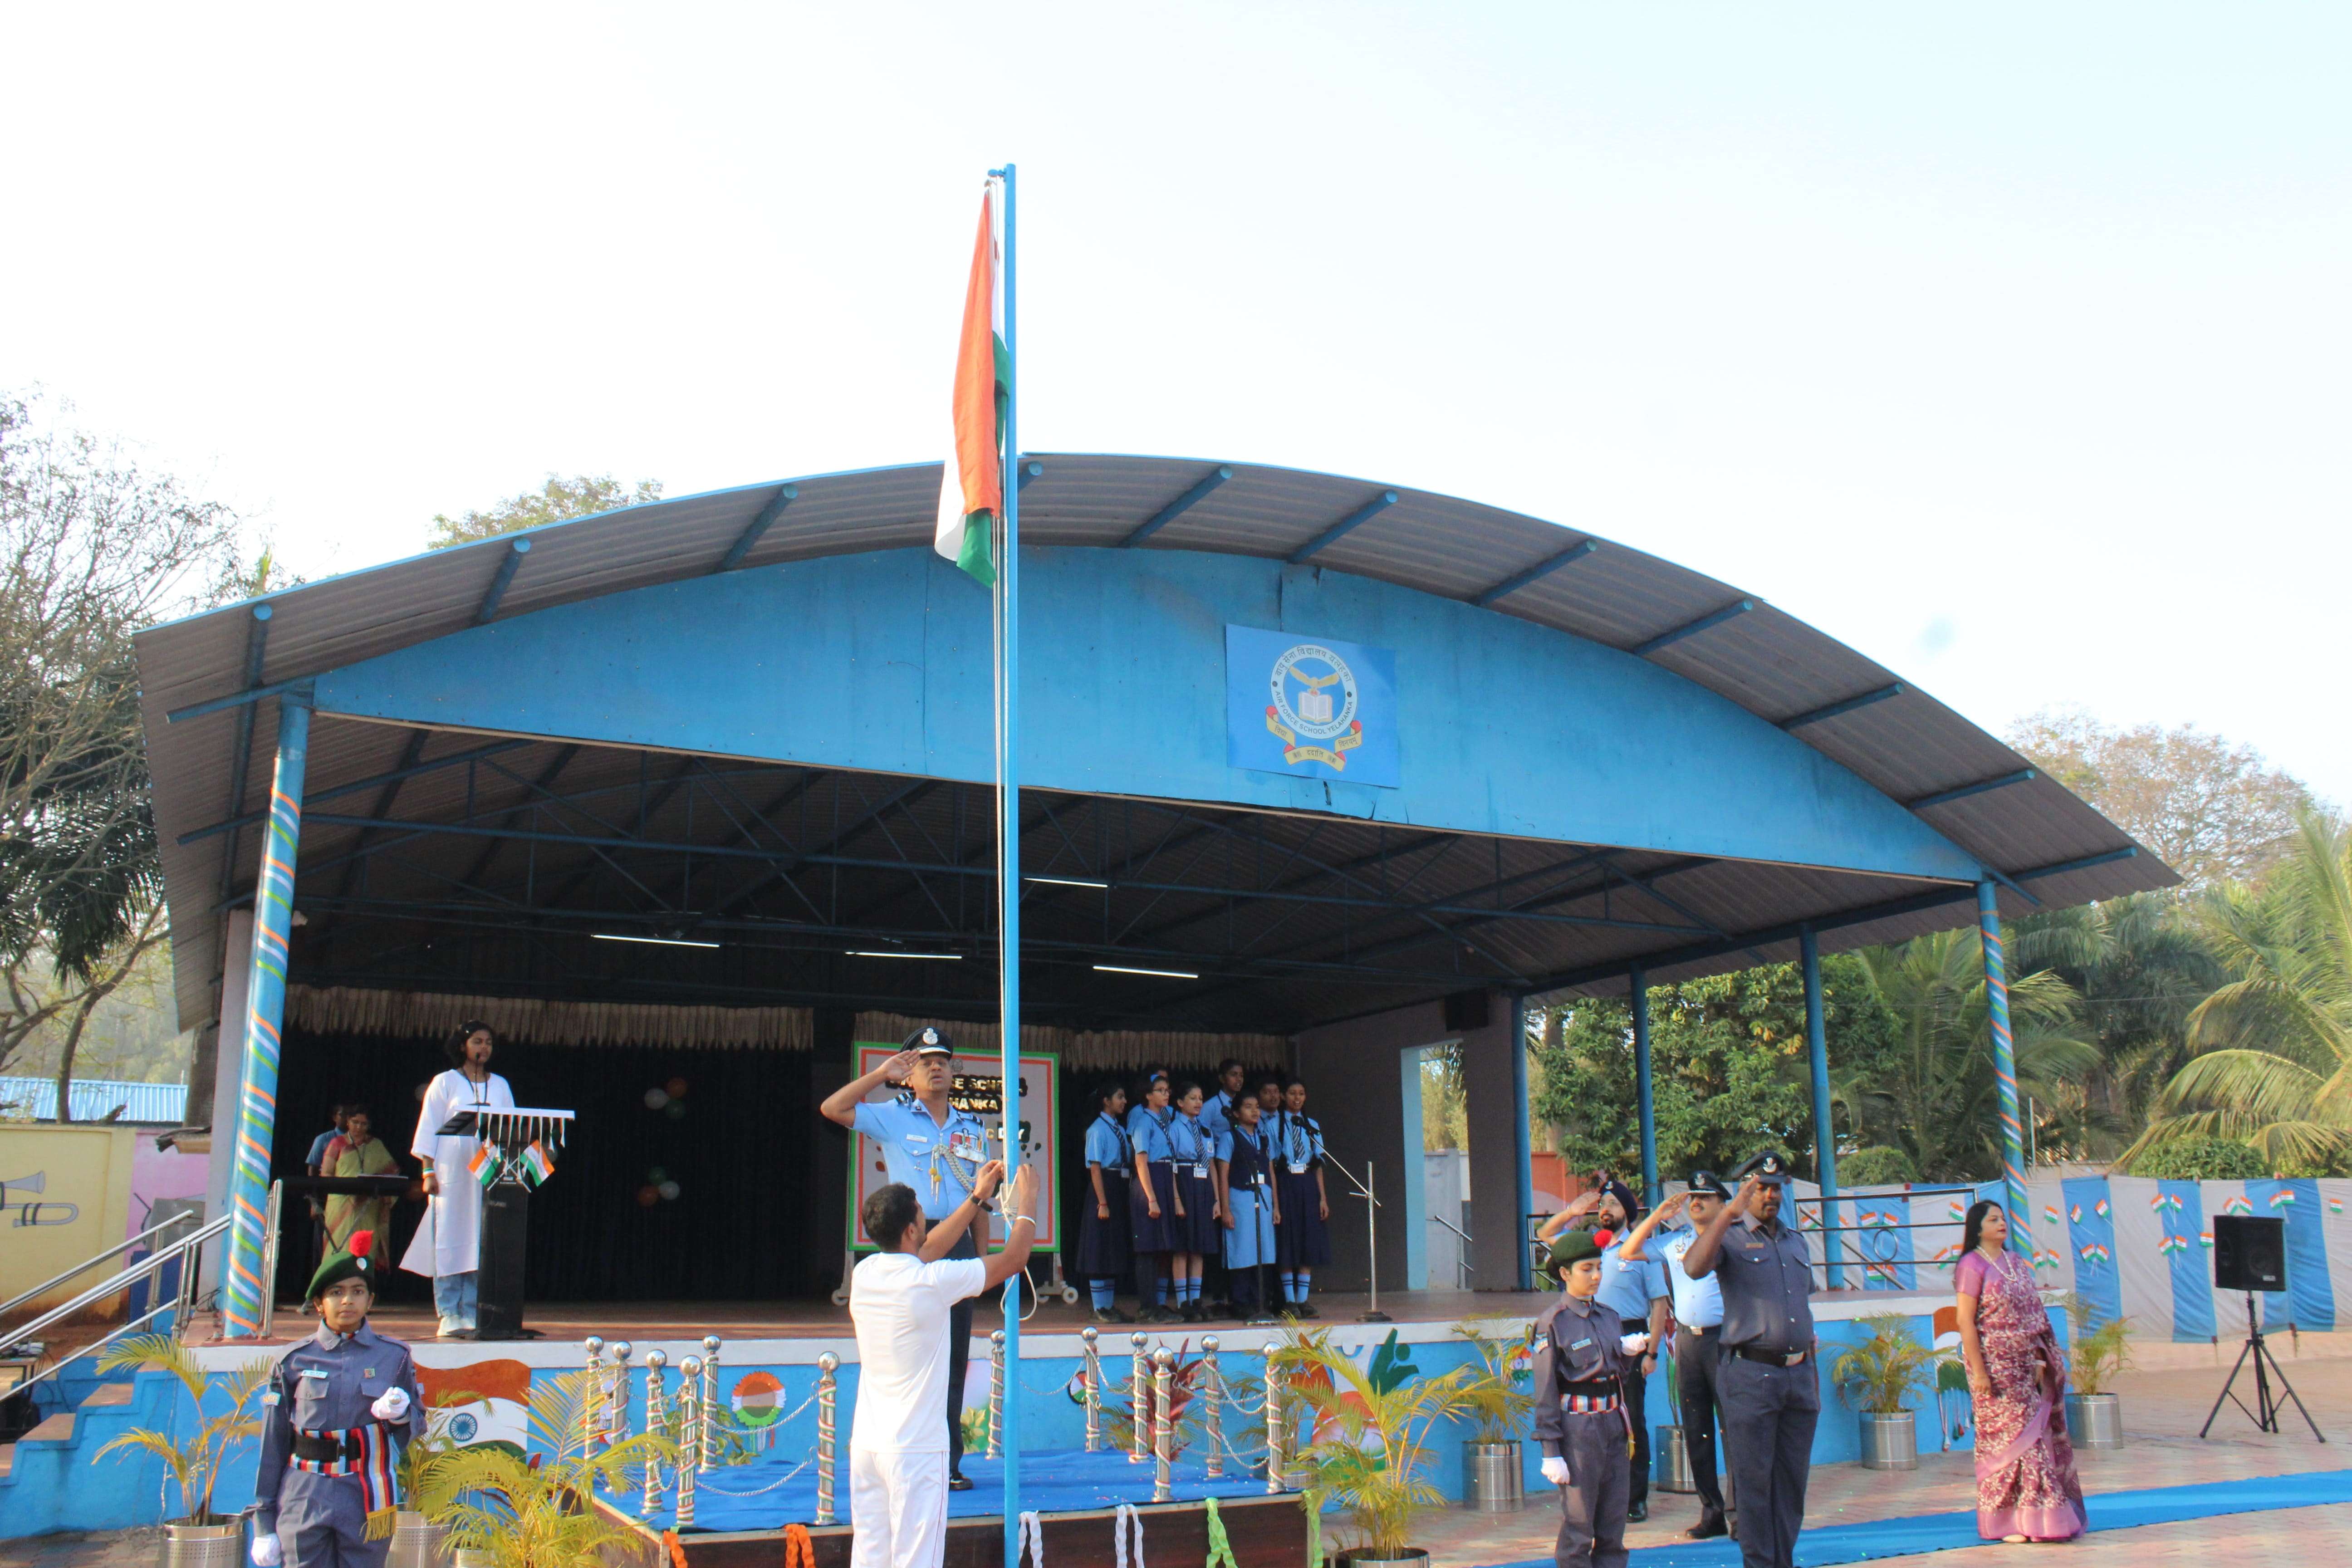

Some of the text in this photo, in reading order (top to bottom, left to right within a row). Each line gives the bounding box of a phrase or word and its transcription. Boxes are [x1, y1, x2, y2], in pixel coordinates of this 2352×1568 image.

[1282, 652, 1296, 663] सेना
[1280, 705, 1299, 725] FORCE
[1299, 723, 1327, 735] SCHOOL
[1327, 701, 1352, 733] YELAHANKA
